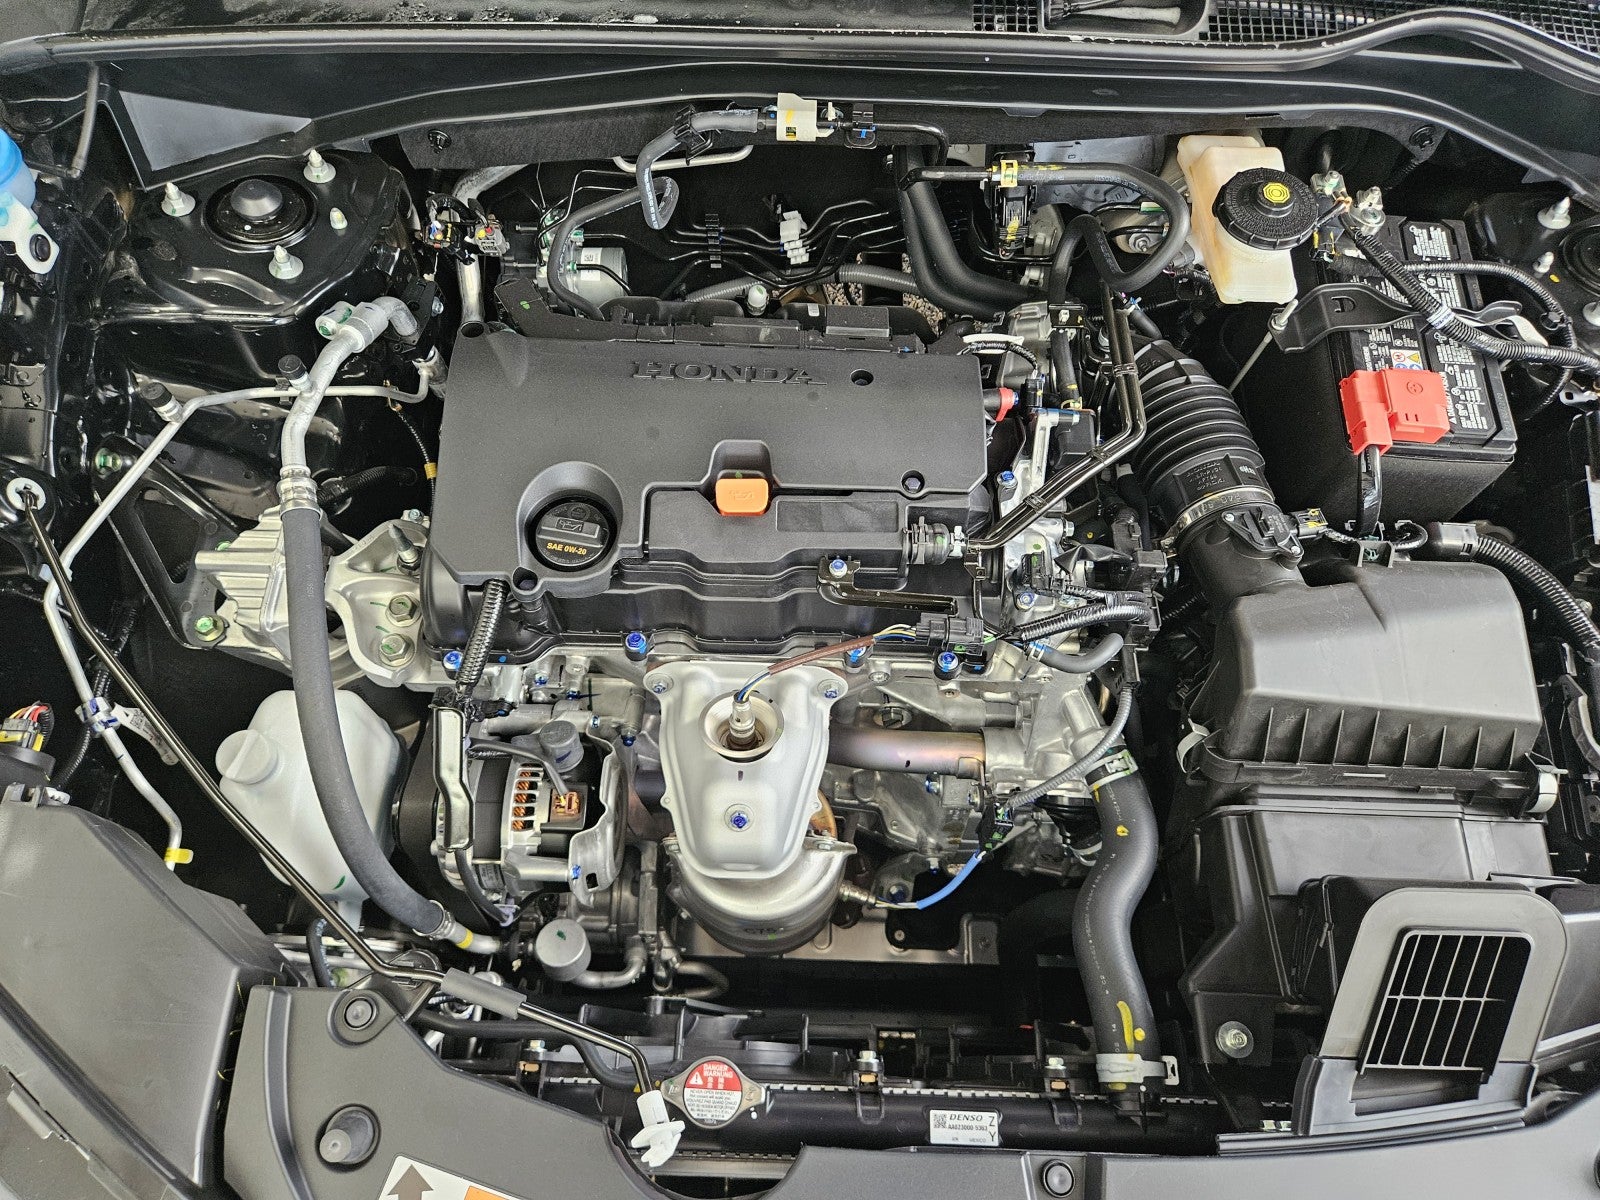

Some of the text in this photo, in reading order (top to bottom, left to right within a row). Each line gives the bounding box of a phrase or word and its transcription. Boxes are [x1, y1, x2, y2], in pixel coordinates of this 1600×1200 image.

[630, 361, 828, 386] HONDA
[546, 542, 587, 556] SAE 0W-20
[989, 1116, 995, 1126] Z
[989, 1132, 996, 1141] Y
